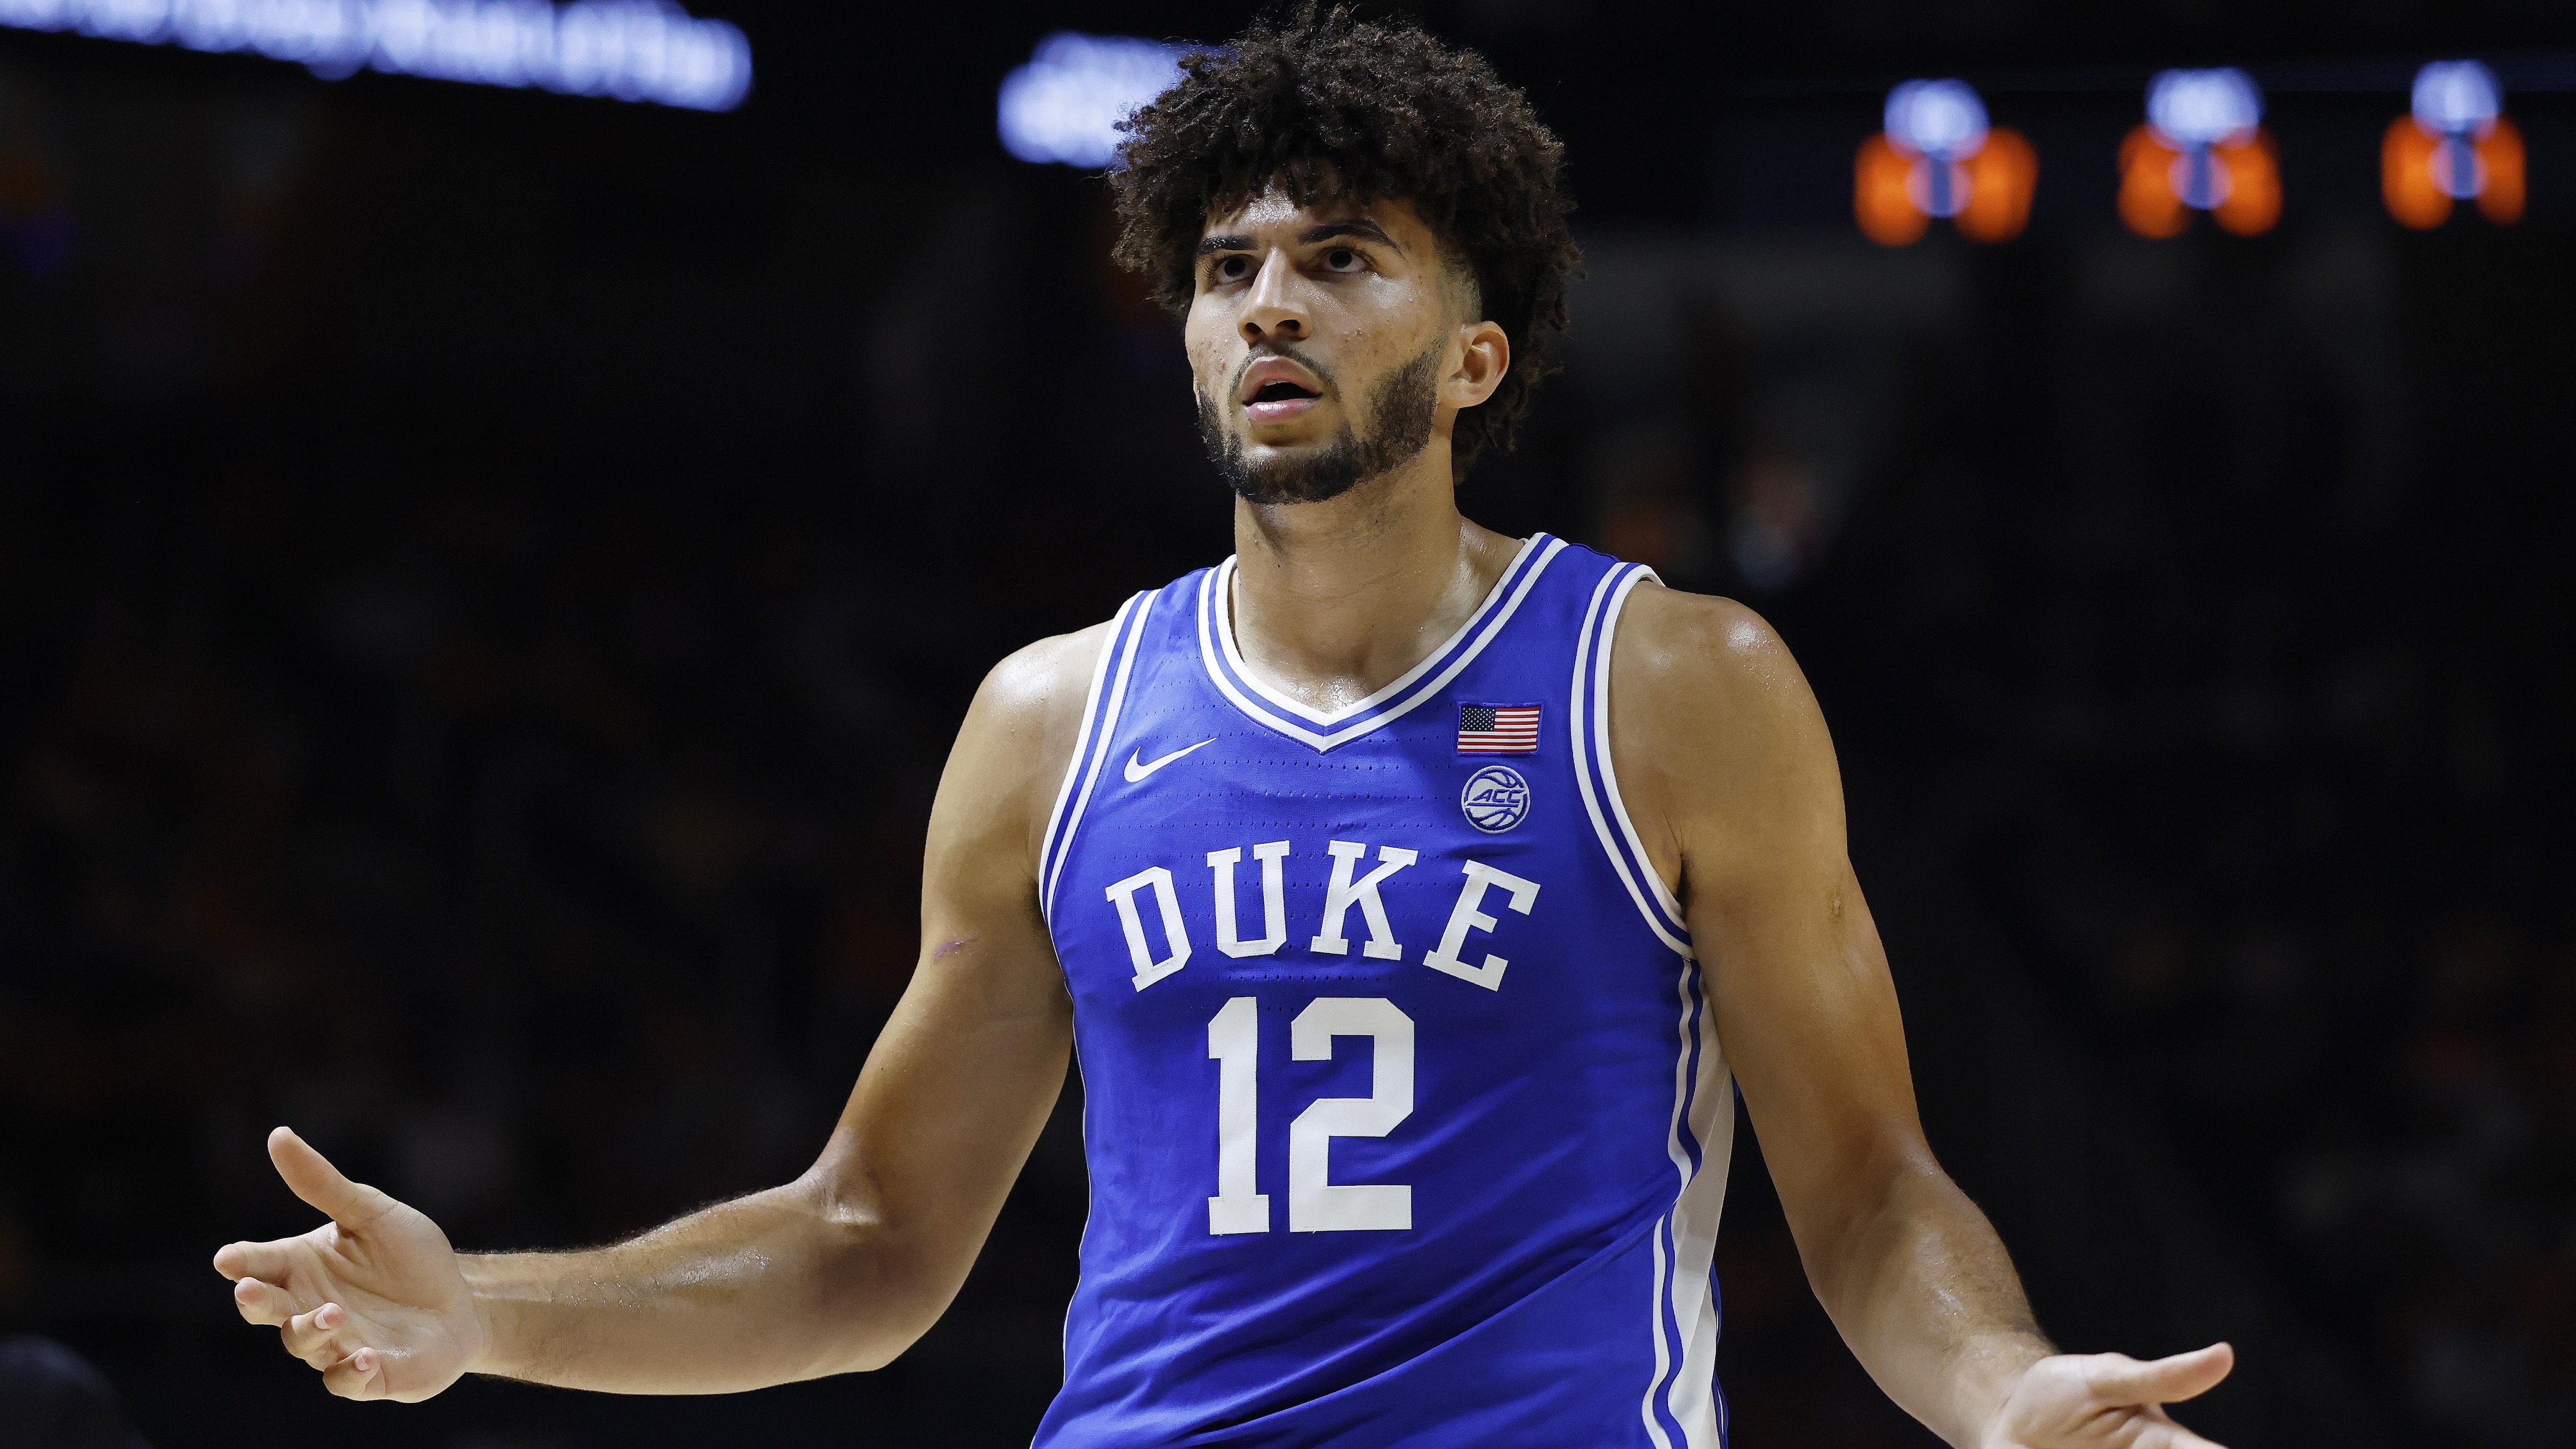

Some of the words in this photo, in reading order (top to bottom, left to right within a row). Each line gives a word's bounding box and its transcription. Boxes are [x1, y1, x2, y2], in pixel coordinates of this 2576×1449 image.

[1472, 789, 1524, 804] ACC
[1105, 840, 1541, 993] DUKE
[1208, 997, 1415, 1236] 12
